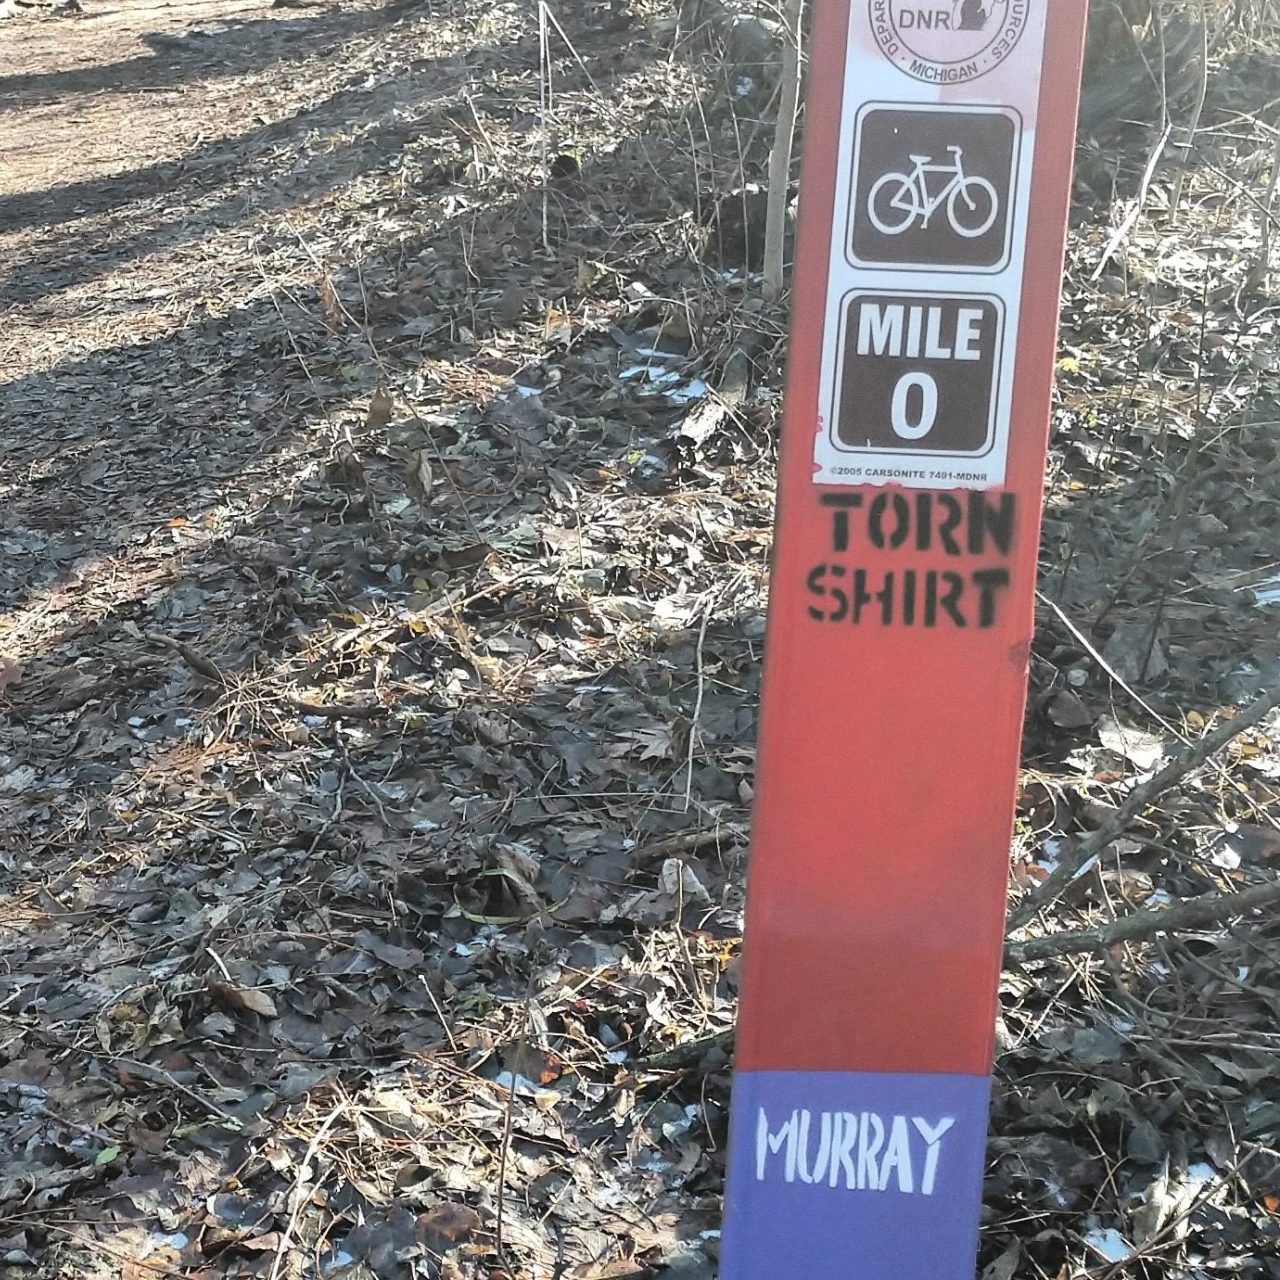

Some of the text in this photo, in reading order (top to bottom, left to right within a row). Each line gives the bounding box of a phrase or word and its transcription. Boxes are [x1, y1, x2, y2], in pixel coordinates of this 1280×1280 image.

[899, 9, 951, 31] DNR
[909, 60, 979, 82] MICHIGAN
[856, 303, 984, 361] MILE
[890, 372, 938, 440] 0
[864, 468, 926, 479] CARSONITE
[928, 471, 987, 482] 7491-MDNR
[819, 491, 1017, 556] TORN
[805, 562, 1011, 629] SHIRT
[756, 1106, 956, 1195] MURRAY
